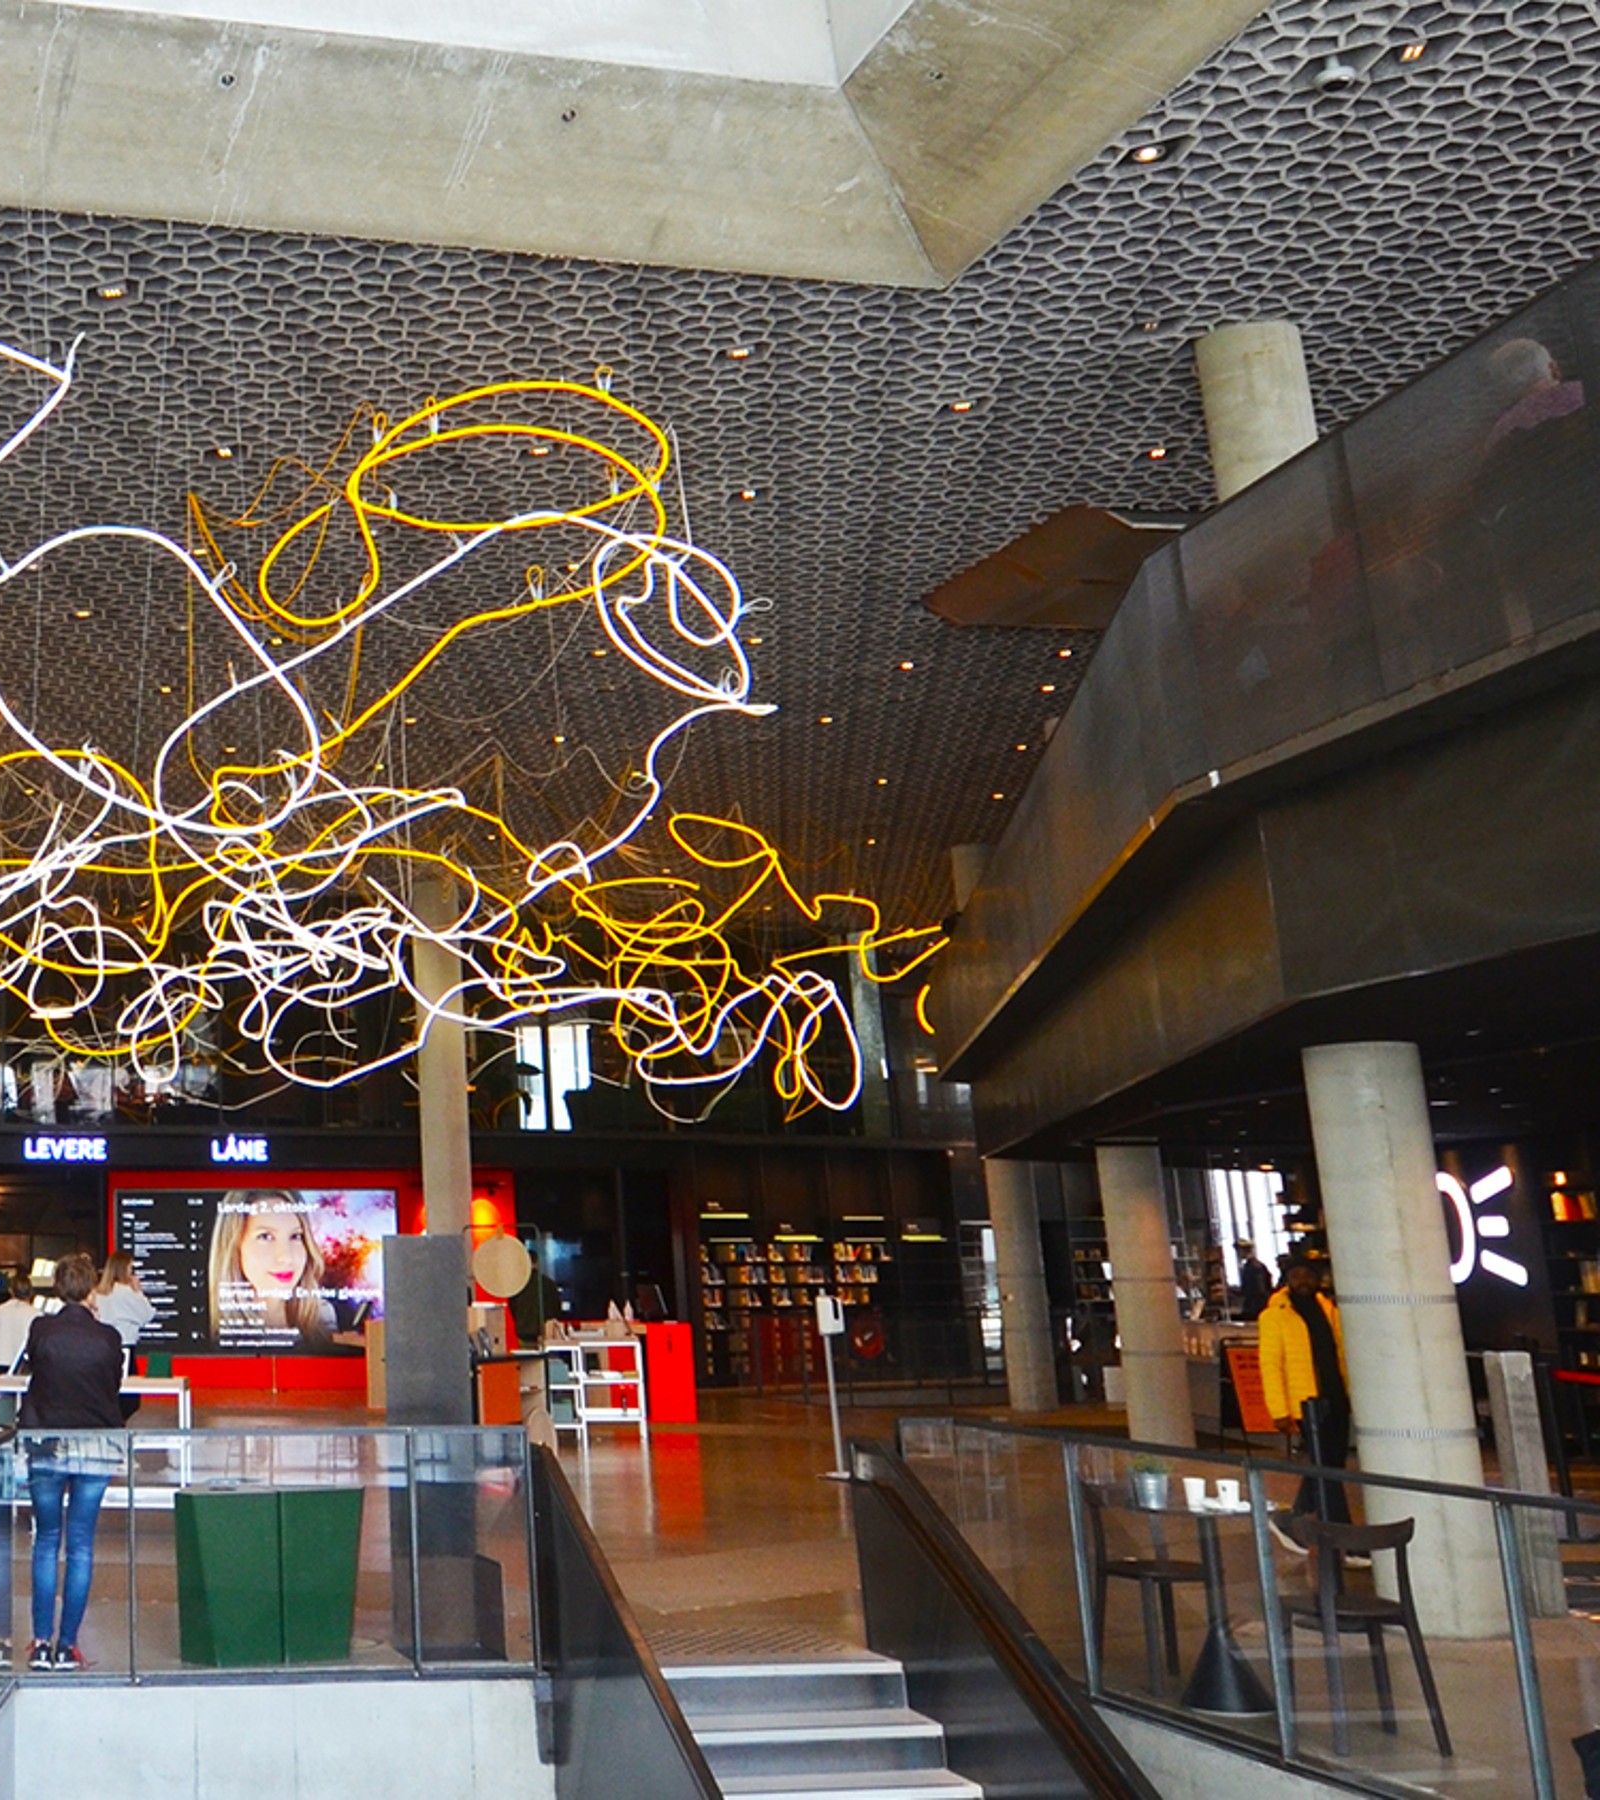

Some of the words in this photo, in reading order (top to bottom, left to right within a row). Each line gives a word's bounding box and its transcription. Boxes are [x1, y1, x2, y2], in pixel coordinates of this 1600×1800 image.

[23, 1136, 107, 1160] LEVERE
[210, 1133, 269, 1161] LÅNE
[260, 1201, 272, 1213] 2.
[273, 1202, 319, 1213] oktober
